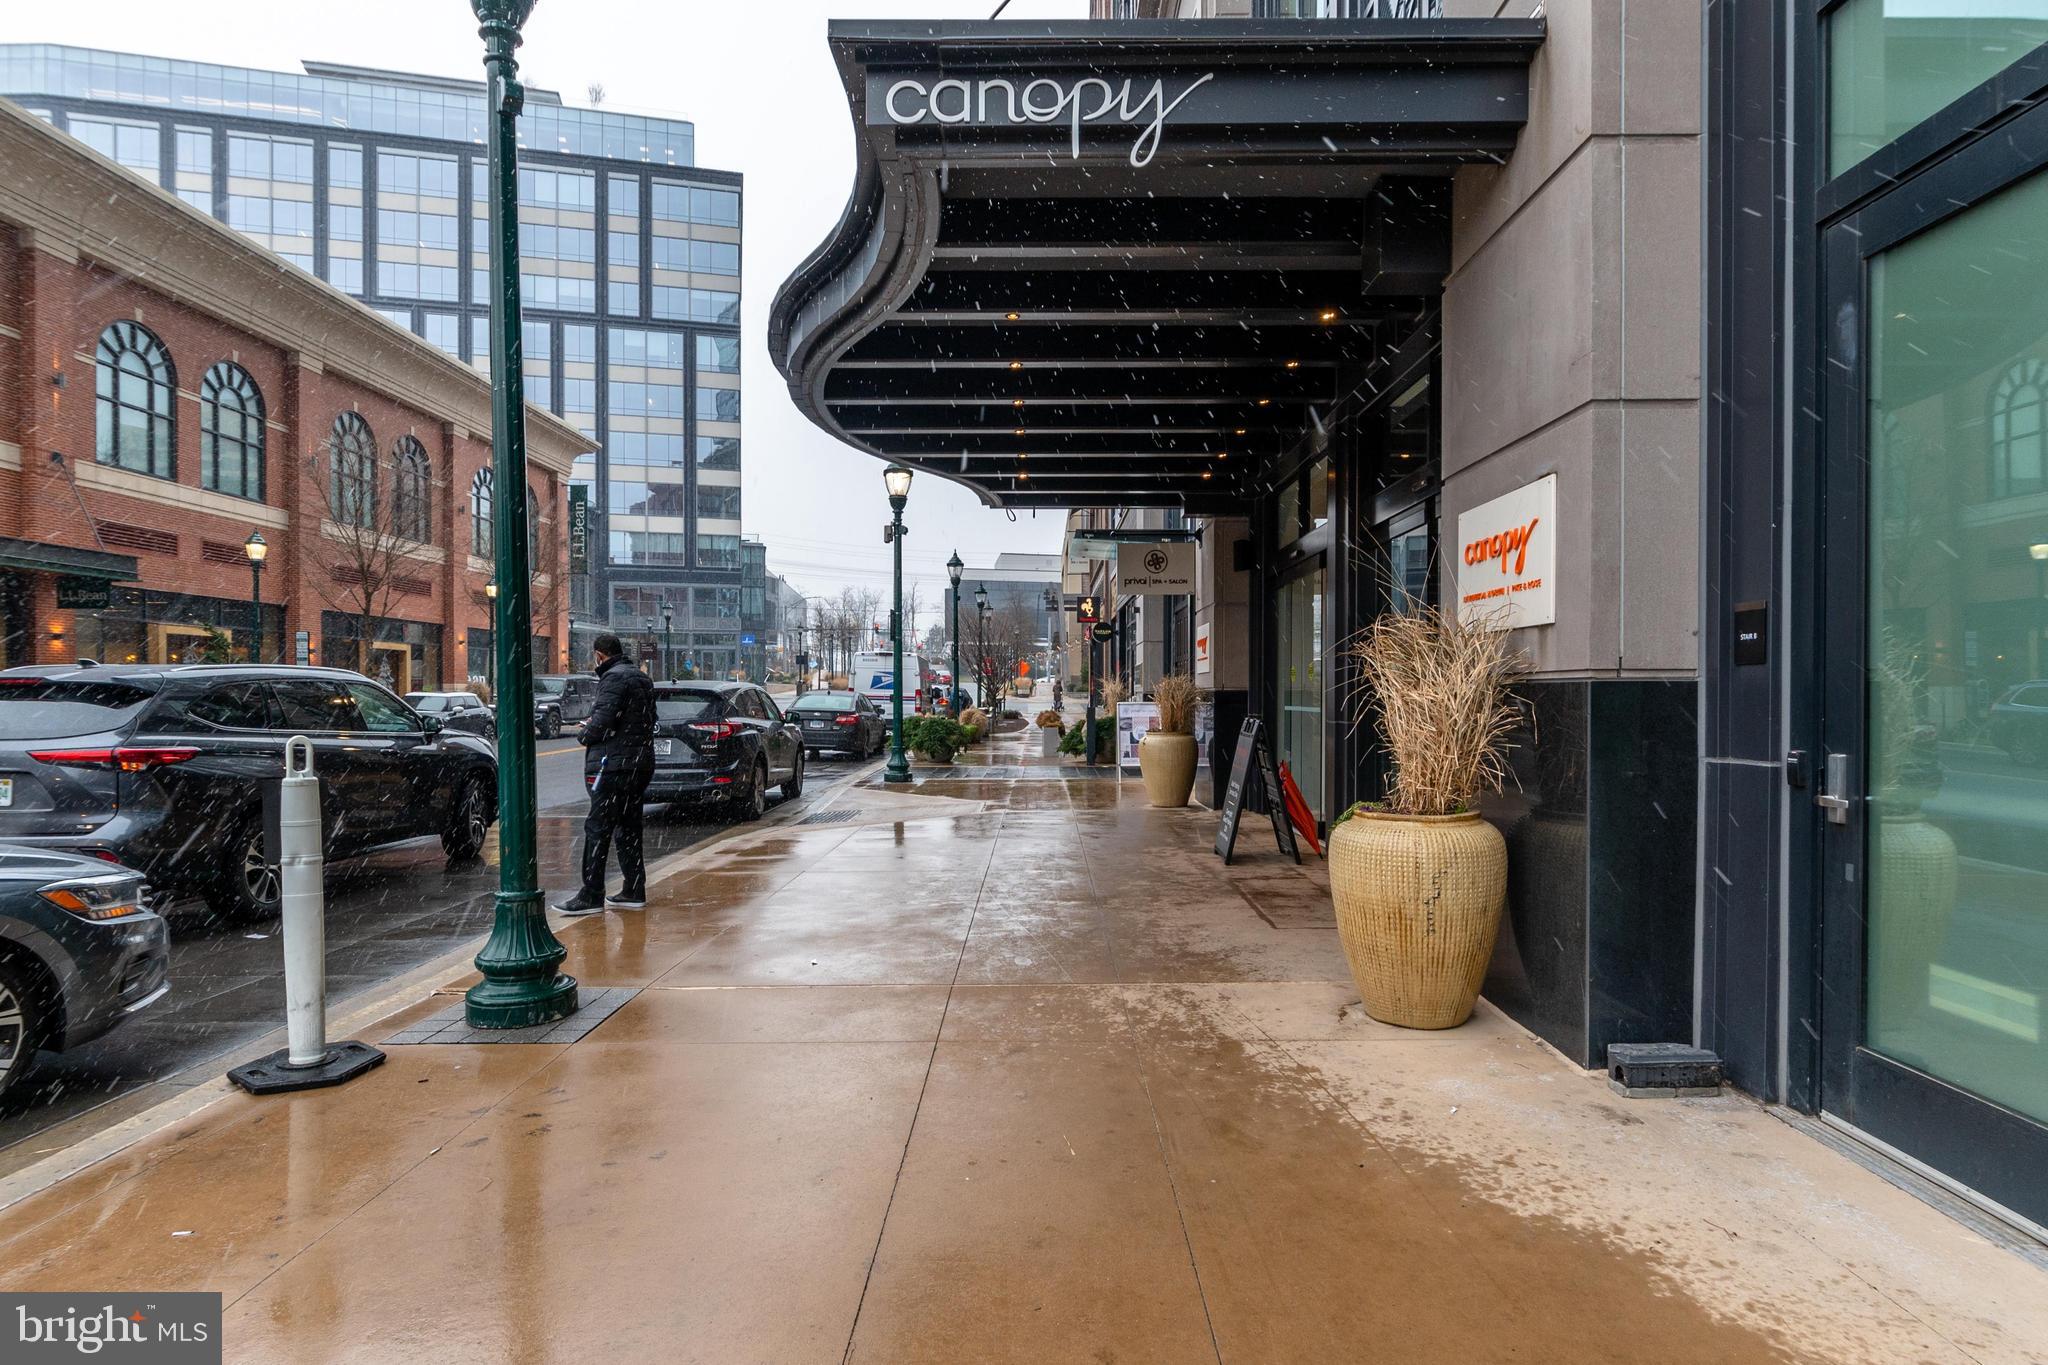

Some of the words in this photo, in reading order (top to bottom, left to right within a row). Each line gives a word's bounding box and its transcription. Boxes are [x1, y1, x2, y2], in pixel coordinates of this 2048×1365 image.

[886, 72, 1214, 168] canopy
[573, 501, 585, 558] L.L.Bean
[1464, 517, 1539, 576] canopy
